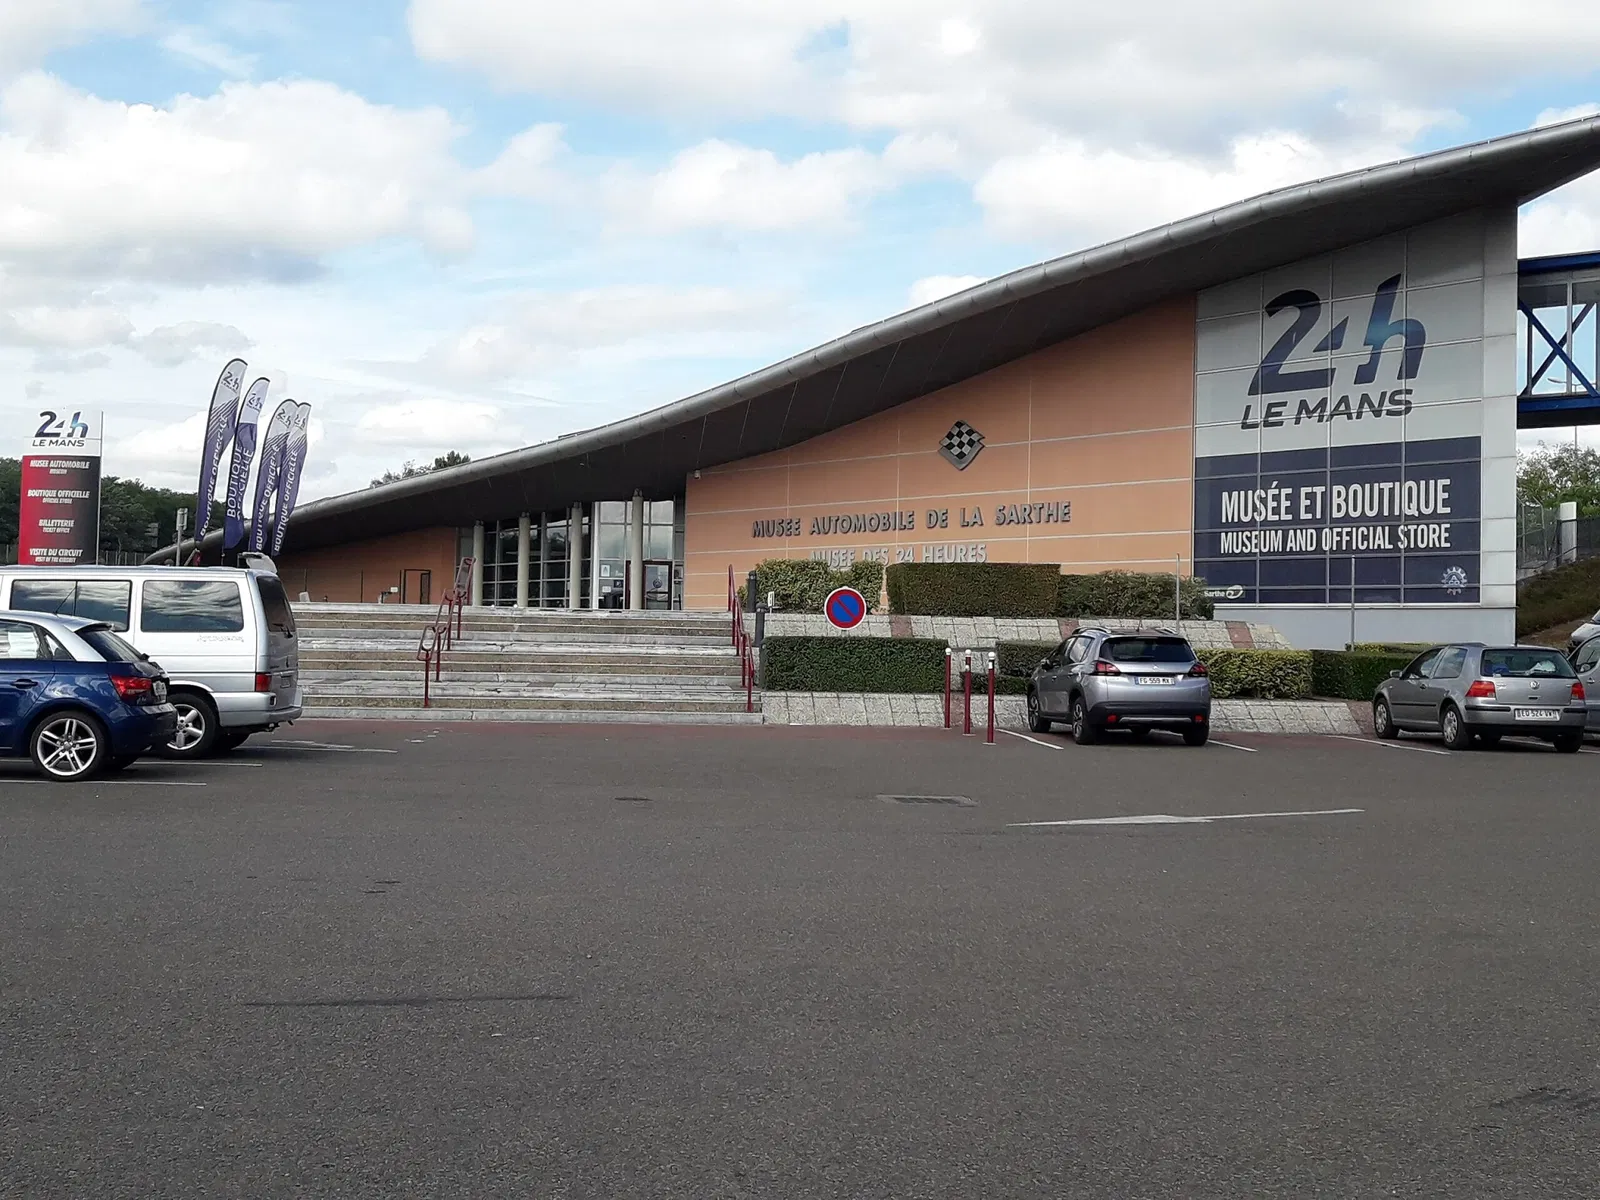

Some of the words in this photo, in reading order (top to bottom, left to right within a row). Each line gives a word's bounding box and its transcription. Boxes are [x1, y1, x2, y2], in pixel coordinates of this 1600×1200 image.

[1240, 401, 1288, 430] LE
[1294, 388, 1413, 425] MANS
[32, 439, 47, 447] LE
[48, 439, 85, 447] MANS
[49, 460, 91, 469] AUTOMOBILE
[27, 489, 57, 498] BOUTIQUE
[57, 490, 91, 499] OFFICIELLE
[226, 443, 243, 518] BOUTIQUE
[274, 503, 288, 552] BOUTIQUE
[283, 450, 299, 501] OFFICIELLE
[1221, 480, 1293, 524] MUSÉE
[1299, 486, 1326, 520] ET
[1331, 478, 1451, 520] BOUTIQUE
[38, 519, 75, 527] BILLETTERIE
[751, 517, 801, 538] MUSEE
[809, 510, 915, 536] AUTOMOBILE
[926, 508, 949, 529] DE
[959, 506, 984, 527] LA
[995, 501, 1071, 526] SARTHE
[29, 548, 48, 556] VISITE
[48, 548, 58, 556] DU
[58, 549, 83, 557] CIRCUIT
[1220, 529, 1283, 555] MUSEUM
[1286, 528, 1317, 553] AND
[1321, 525, 1394, 551] OFFICIAL
[1397, 523, 1451, 549] STORE
[863, 548, 890, 566] DES
[896, 546, 915, 563] 24
[922, 543, 988, 563] HEURES
